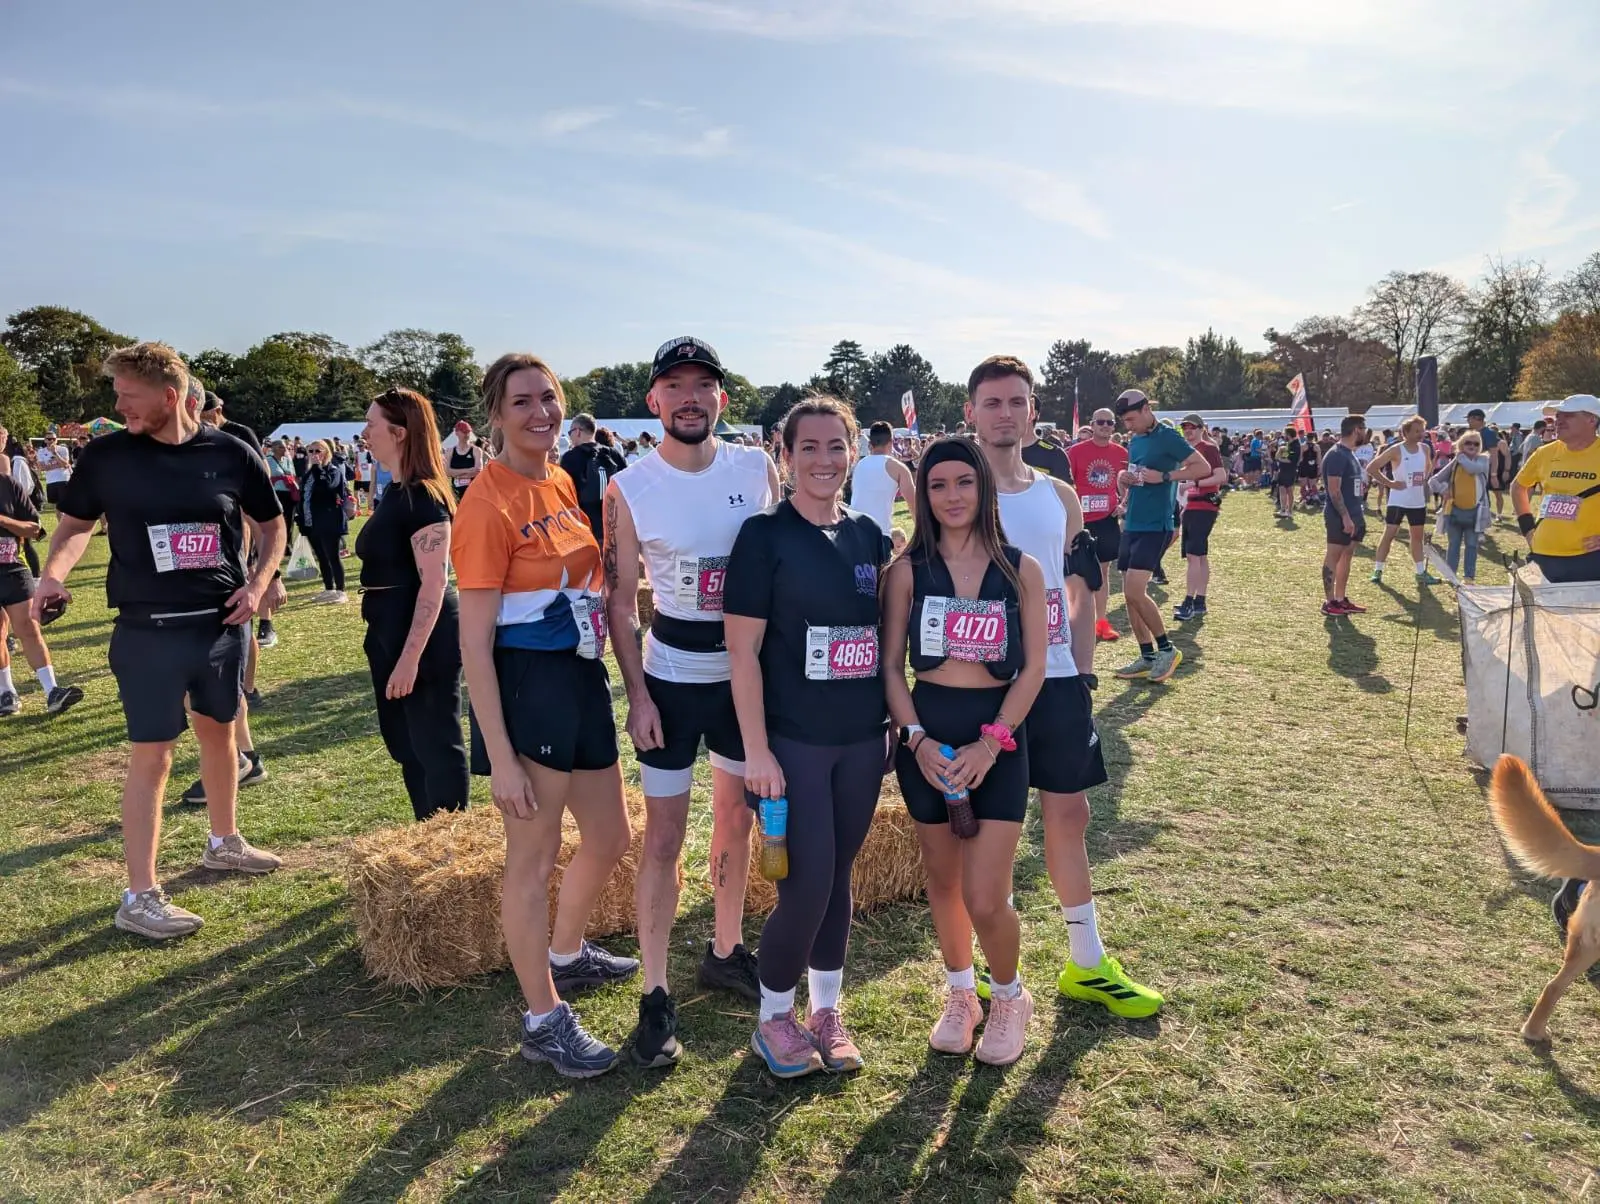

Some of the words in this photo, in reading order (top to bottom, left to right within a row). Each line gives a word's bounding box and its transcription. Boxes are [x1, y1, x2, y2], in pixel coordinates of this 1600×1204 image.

[1550, 470, 1597, 480] BEDFORD
[1548, 501, 1577, 515] 5039
[177, 534, 214, 553] 4577
[952, 615, 999, 641] 4170
[833, 642, 874, 667] 4865
